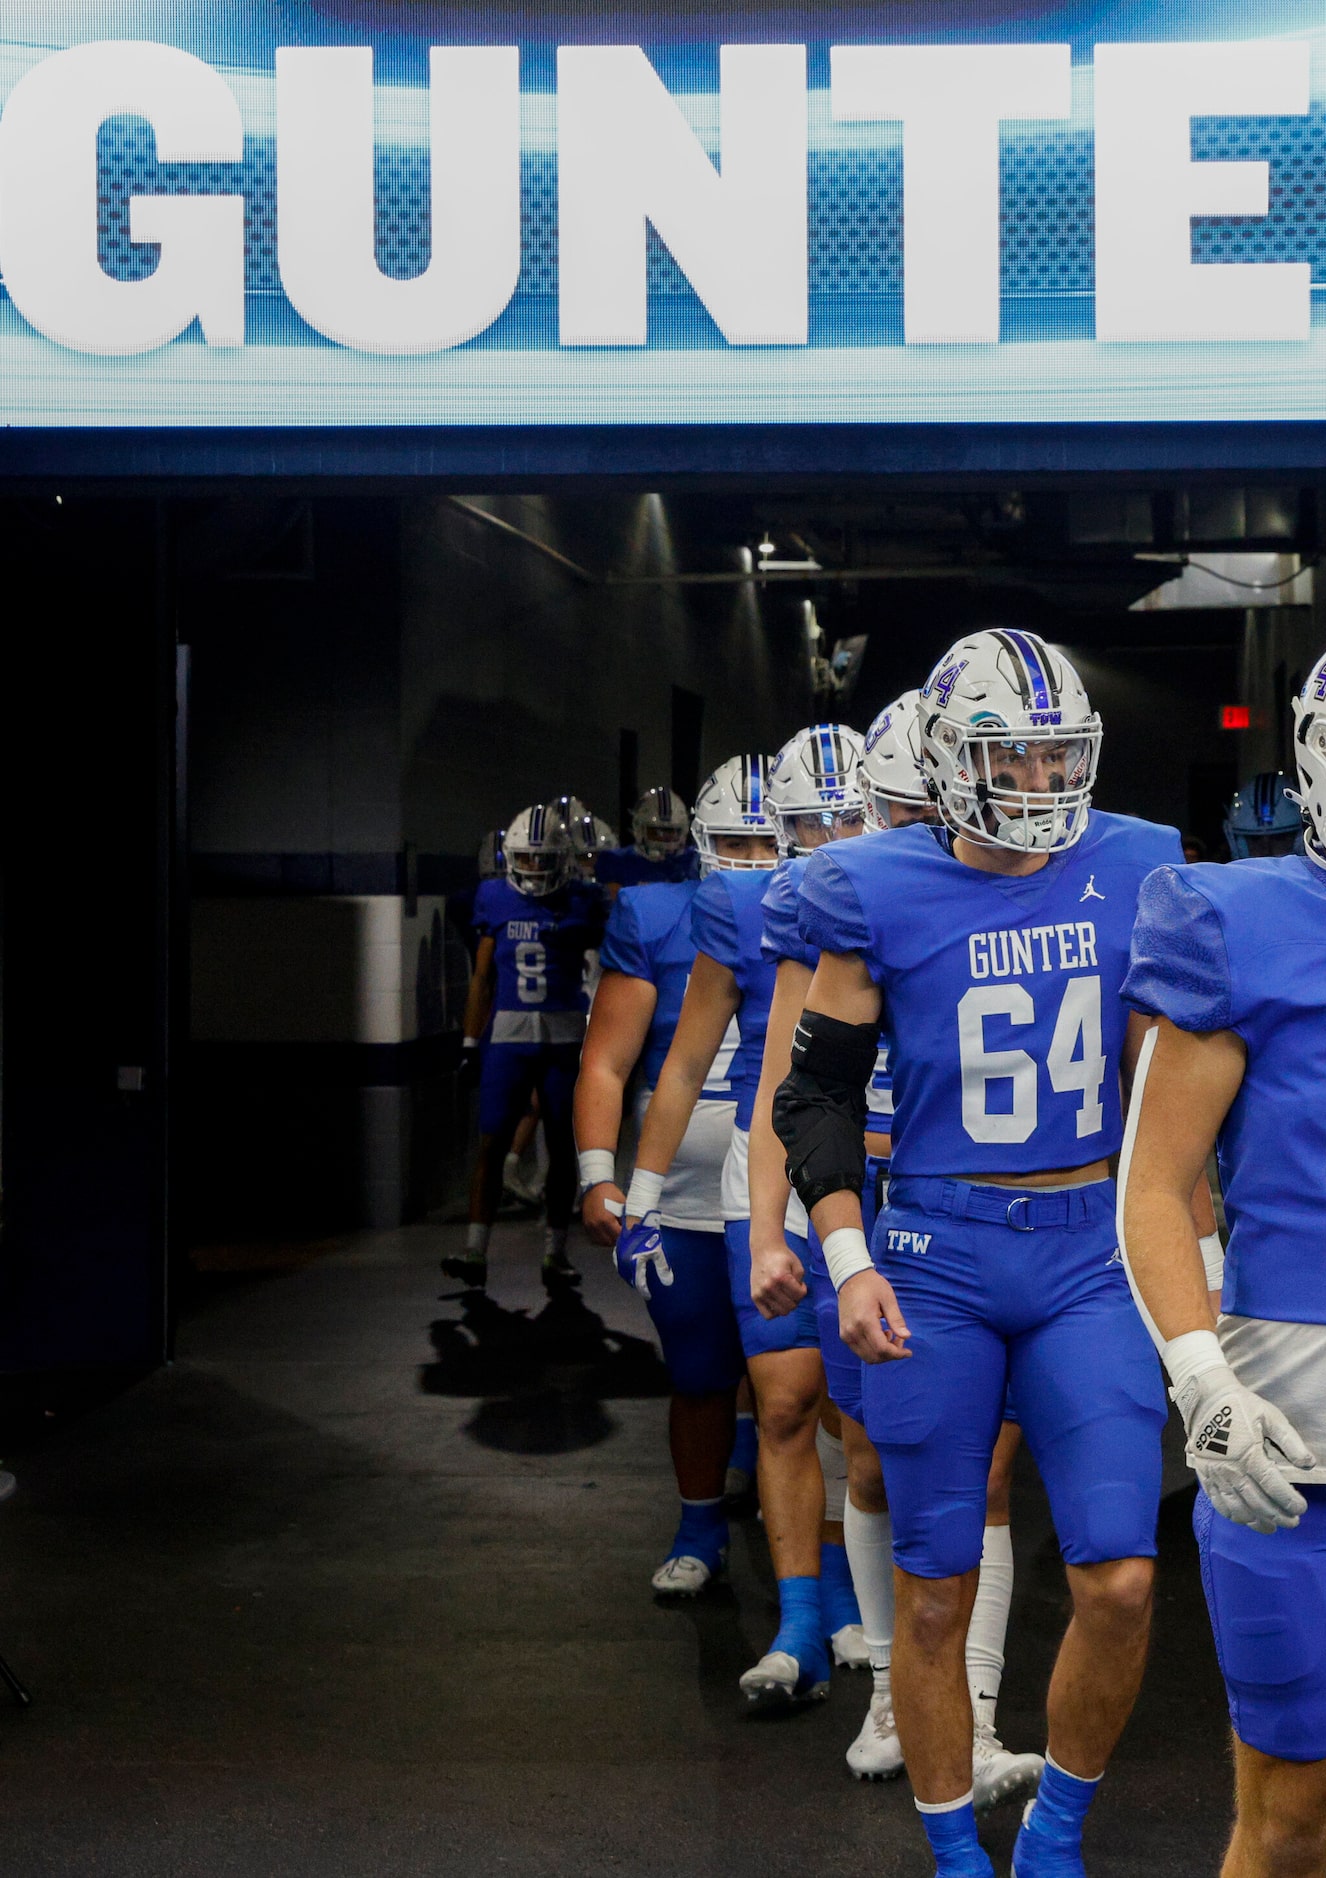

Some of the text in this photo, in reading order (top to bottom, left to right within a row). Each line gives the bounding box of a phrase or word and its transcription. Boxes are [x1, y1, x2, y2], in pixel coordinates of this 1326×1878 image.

[515, 942, 548, 1004] 8
[968, 921, 1098, 980] GUNTER
[957, 975, 1107, 1144] 64
[887, 1230, 932, 1255] TPW
[1196, 1405, 1232, 1452] adidas
